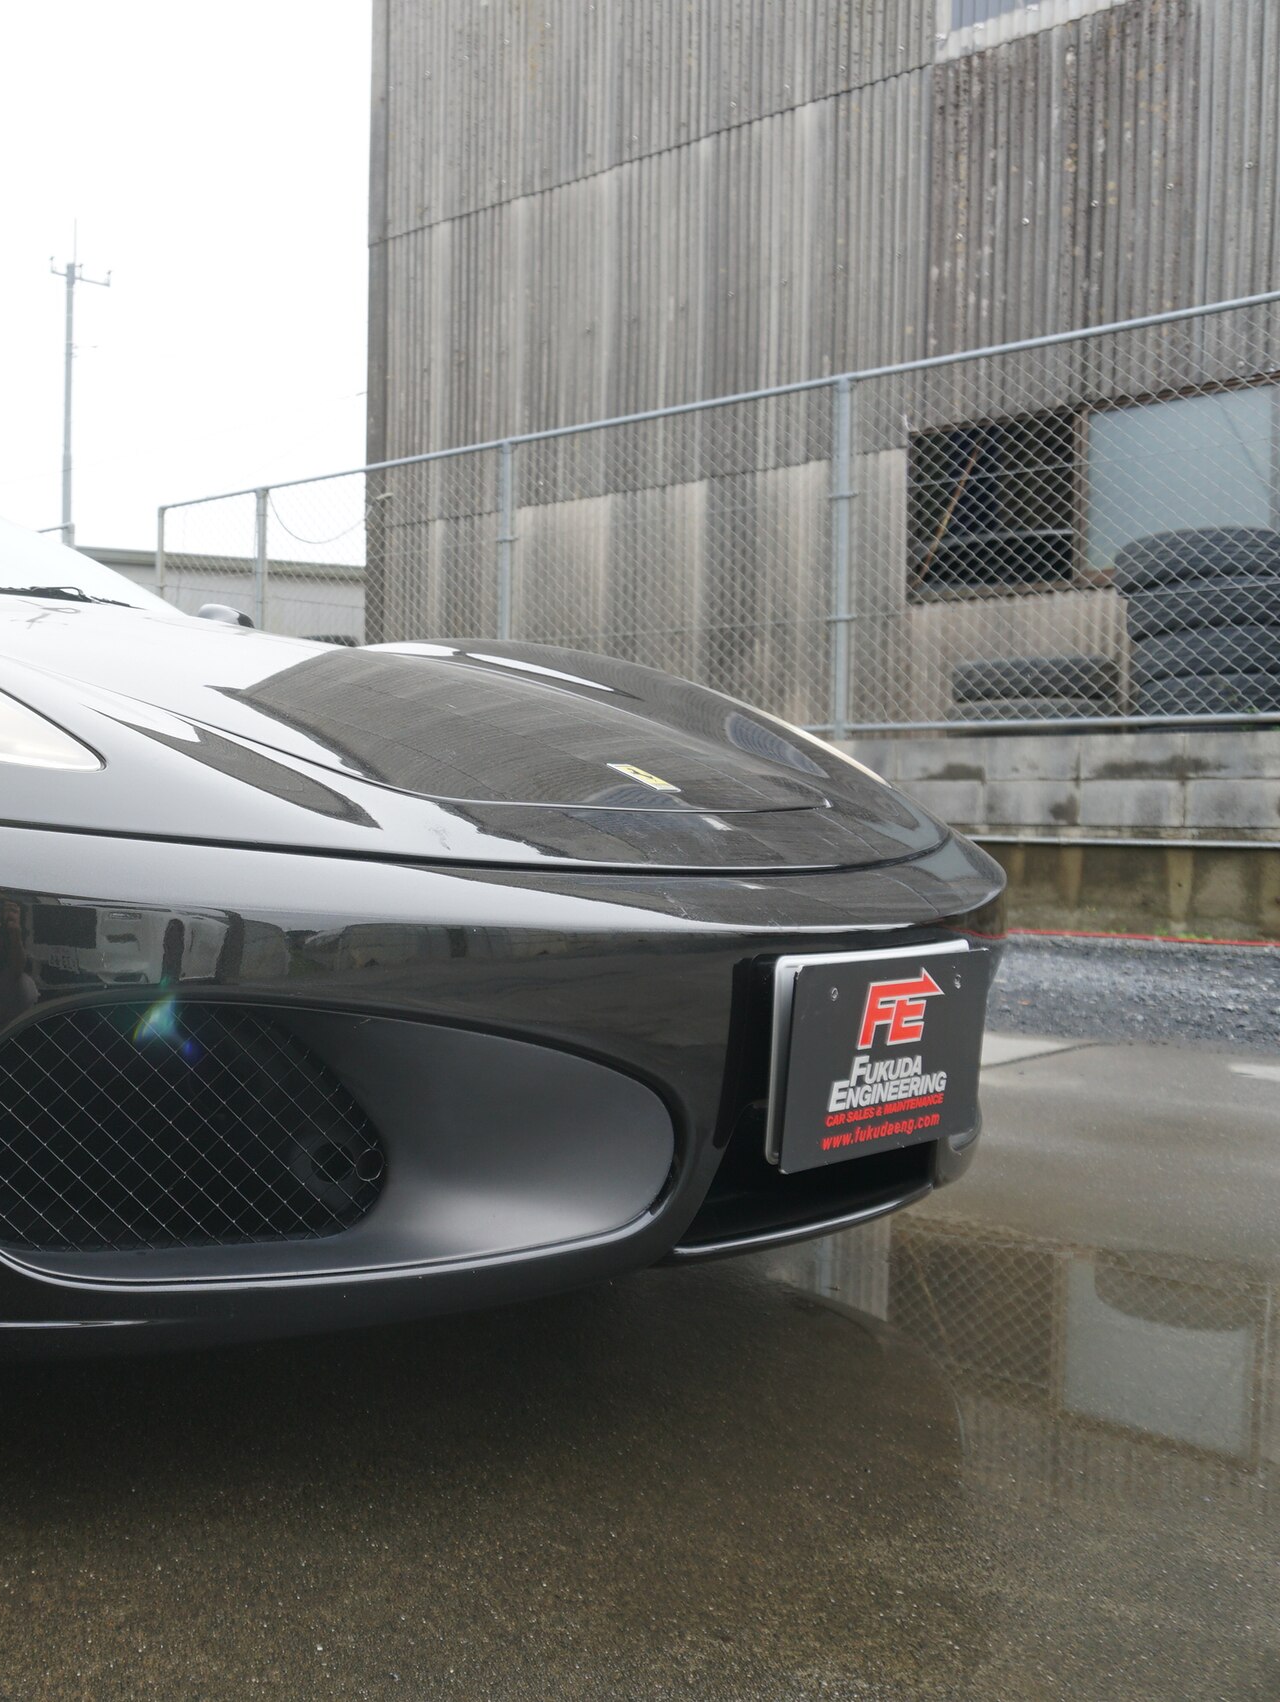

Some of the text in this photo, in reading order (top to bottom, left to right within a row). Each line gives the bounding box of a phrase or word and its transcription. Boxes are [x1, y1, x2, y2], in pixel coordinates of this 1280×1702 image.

[856, 967, 945, 1050] FE
[850, 1055, 922, 1087] FUKUDA
[825, 1093, 944, 1127] CAR SALES & MAINTENANCE
[828, 1071, 947, 1112] ENGINEERING
[822, 1113, 940, 1151] www.fukudaeng.com
